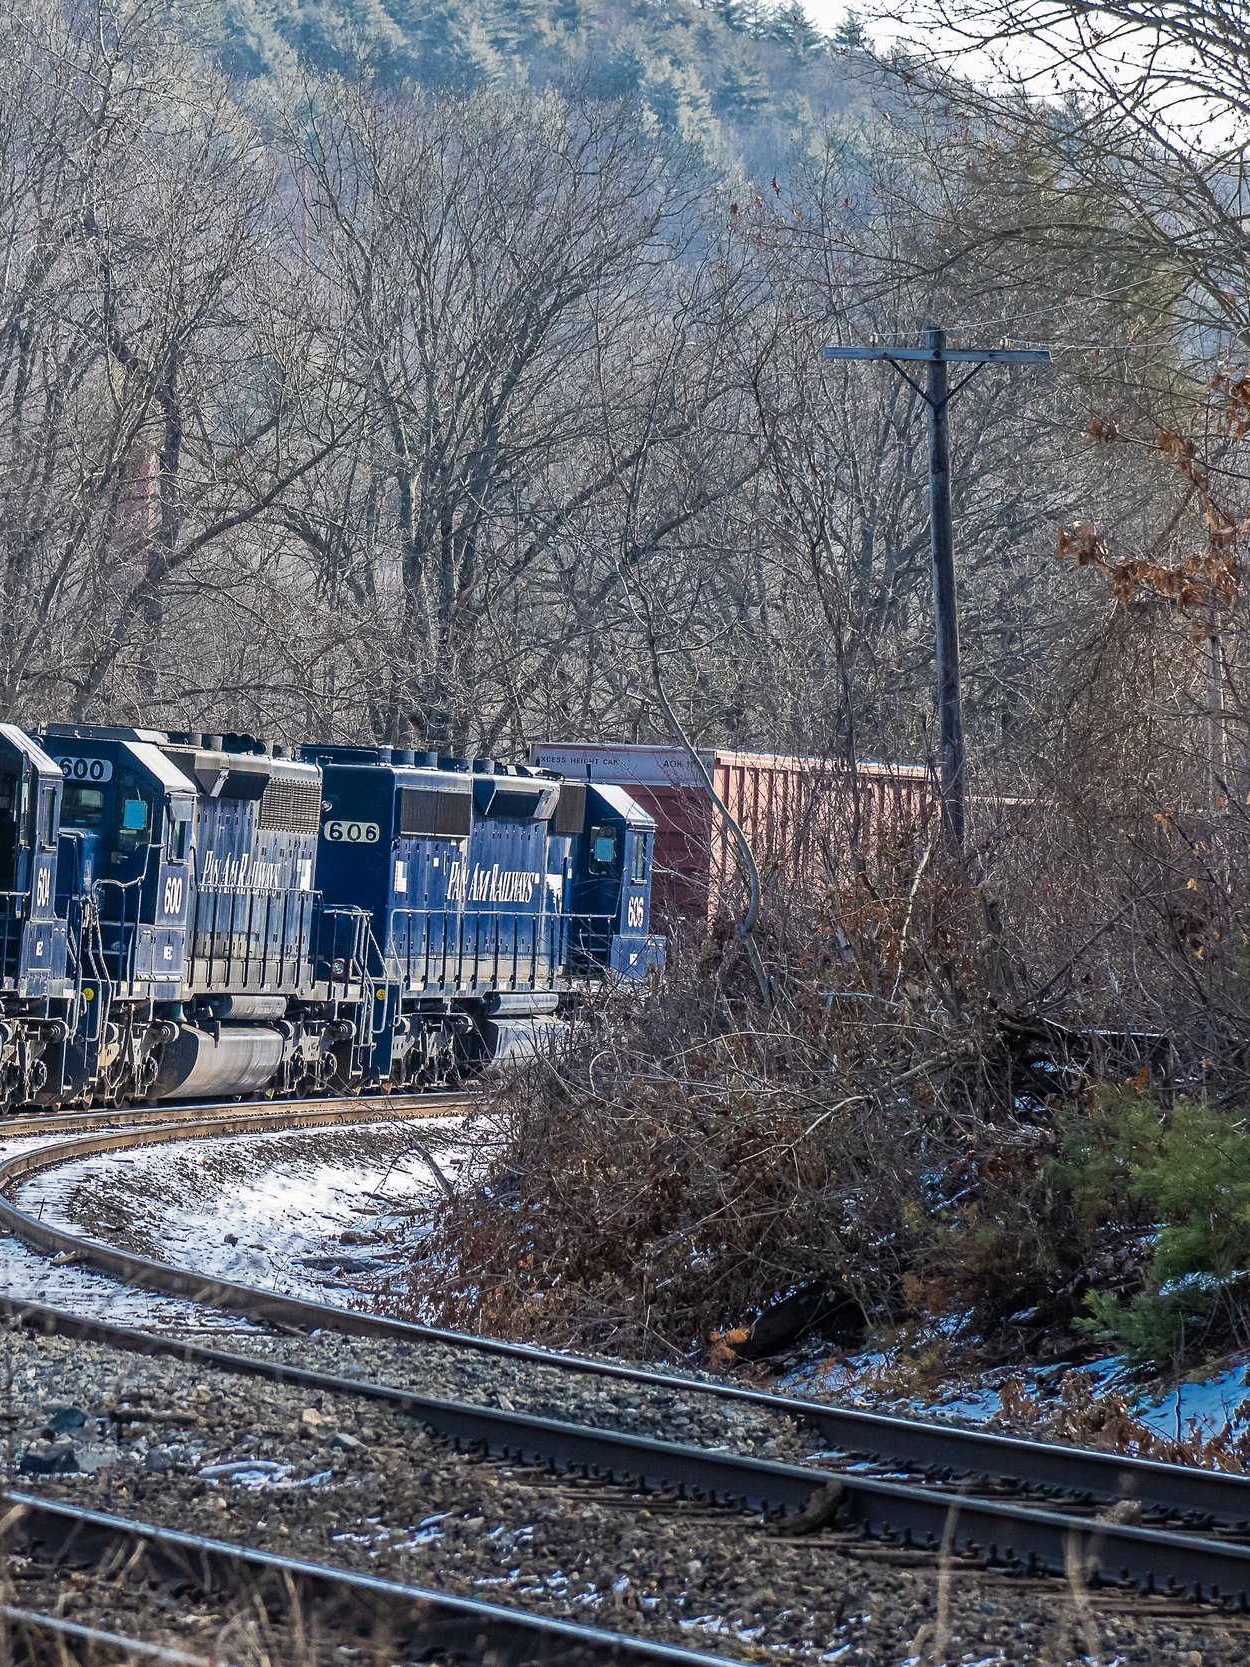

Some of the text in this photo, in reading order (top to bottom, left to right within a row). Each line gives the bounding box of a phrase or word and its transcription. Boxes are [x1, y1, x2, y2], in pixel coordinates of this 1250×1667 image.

[59, 757, 105, 780] 600
[570, 757, 599, 765] HEIGHT
[602, 758, 619, 766] CAR
[329, 821, 377, 842] 606
[198, 850, 222, 893] PAN
[219, 852, 239, 894] AM
[447, 861, 470, 900] PAN
[467, 862, 491, 902] AM
[489, 863, 535, 903] RAILWAYS
[164, 876, 183, 914] 600
[628, 896, 644, 928] 606
